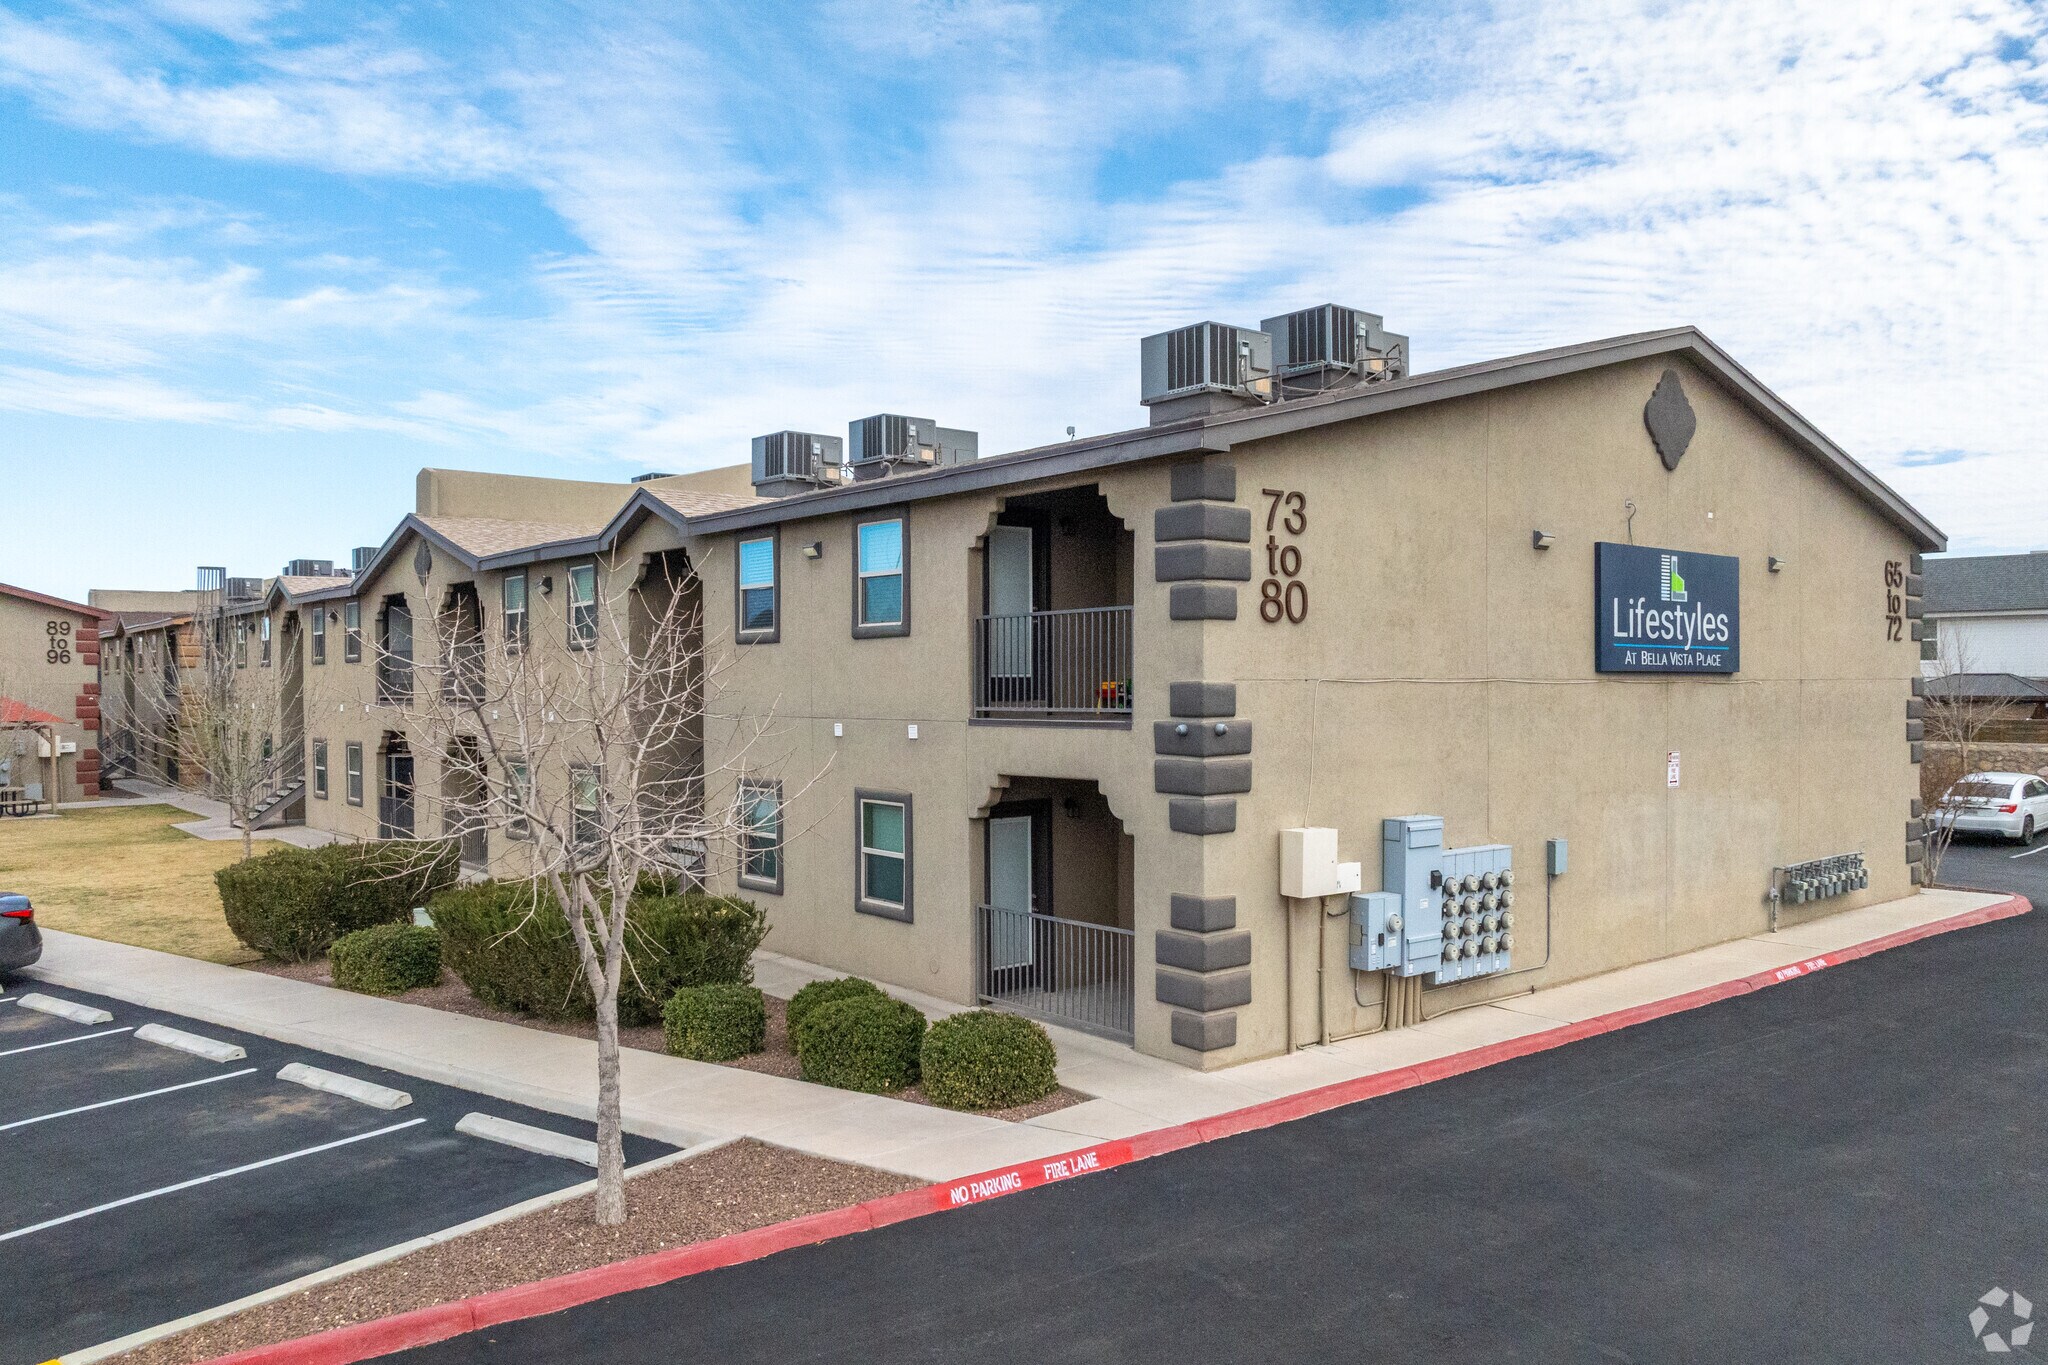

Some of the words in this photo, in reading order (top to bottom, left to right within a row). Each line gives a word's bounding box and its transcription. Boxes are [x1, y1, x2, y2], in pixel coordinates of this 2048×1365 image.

[1262, 488, 1307, 535] 73
[1266, 535, 1302, 577] to
[1885, 560, 1903, 588] 65
[1260, 579, 1308, 624] 80
[1887, 589, 1901, 614] to
[46, 621, 71, 635] 89
[1613, 597, 1729, 651] Lifestyles
[1886, 615, 1903, 641] 72
[49, 635, 68, 649] to
[46, 649, 71, 664] 96
[950, 1186, 969, 1204] NO
[970, 1172, 1021, 1199] PARKING
[1043, 1160, 1070, 1180] FIRE
[1069, 1152, 1099, 1173] LANE
